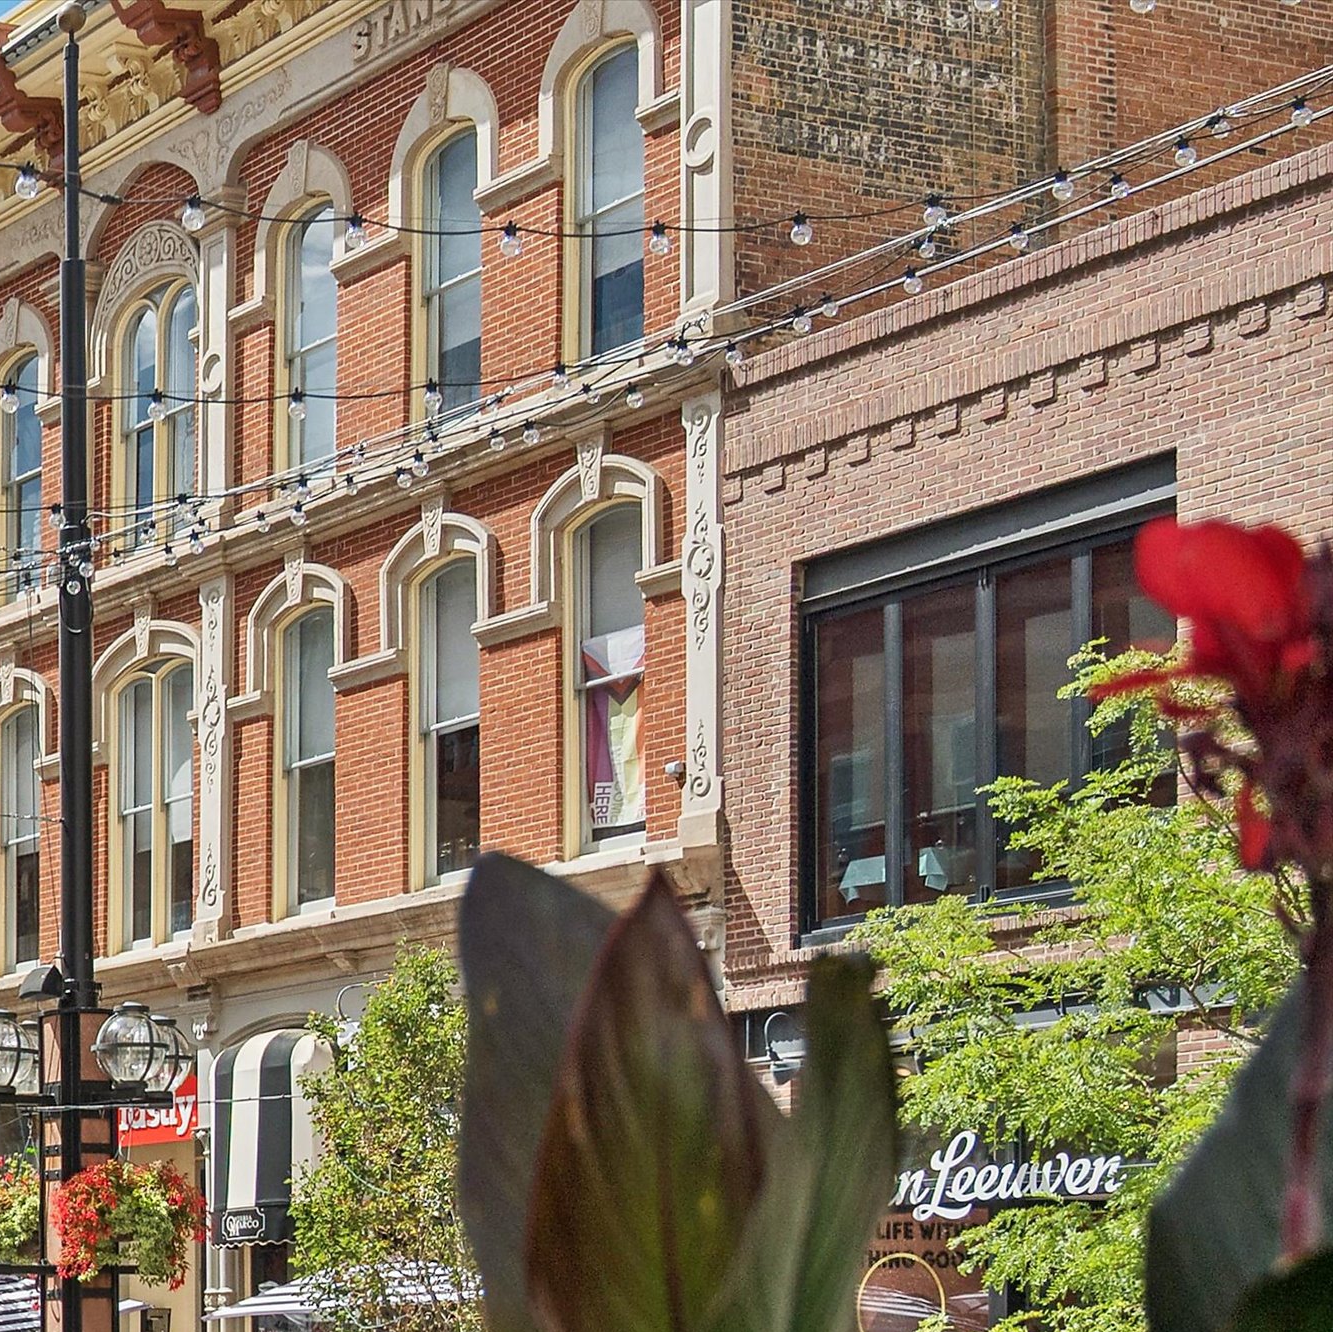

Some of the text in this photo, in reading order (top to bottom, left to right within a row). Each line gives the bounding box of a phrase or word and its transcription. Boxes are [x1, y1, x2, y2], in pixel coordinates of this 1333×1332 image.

[596, 785, 612, 825] HERE
[912, 1130, 1127, 1221] Leeuwen
[877, 1222, 914, 1240] LIFE
